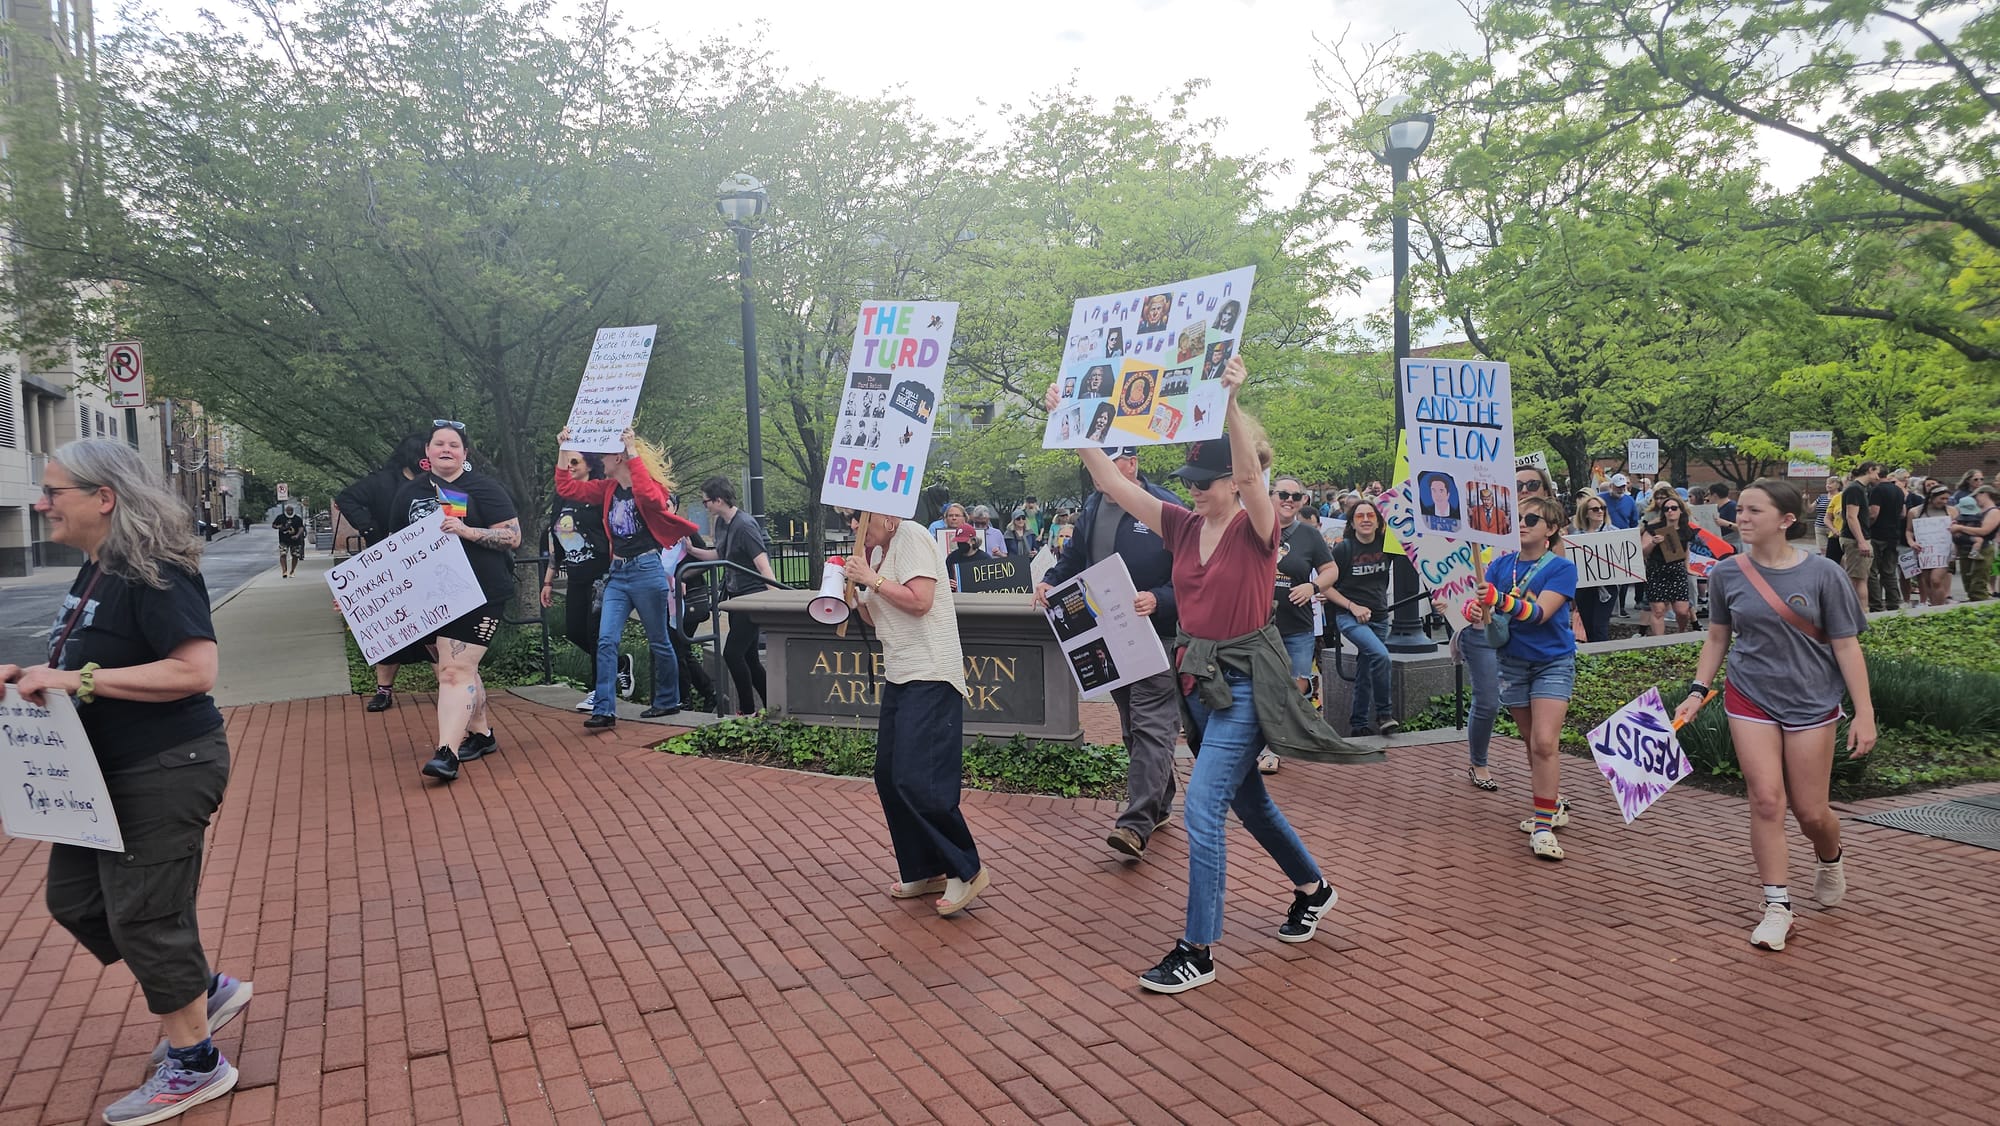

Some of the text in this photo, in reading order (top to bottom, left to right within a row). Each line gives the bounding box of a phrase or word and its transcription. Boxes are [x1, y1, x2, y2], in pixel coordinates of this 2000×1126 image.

[863, 306, 914, 335] THE
[864, 338, 939, 368] TURD
[1407, 363, 1496, 399] F'ELON
[1416, 396, 1500, 426] AND THE
[1419, 426, 1500, 462] FELON
[1630, 451, 1656, 460] FIGHT
[1631, 441, 1650, 450] WE
[828, 456, 915, 495] REICH
[1630, 462, 1655, 472] BACK
[357, 550, 383, 568] THIS
[386, 540, 397, 552] IS
[401, 527, 424, 544] HOW
[1565, 541, 1637, 582] TRUMP
[339, 535, 450, 611] DEMOCRACY DIES WITH
[973, 561, 1015, 583] DEFEND
[350, 579, 413, 624] THUNDEROUS
[365, 642, 385, 660] CAN
[387, 634, 398, 649] WE
[399, 622, 421, 642] MAYBE
[3, 725, 29, 747] Right
[39, 727, 66, 749] Left
[1594, 720, 1681, 781] RESIST
[47, 763, 70, 777] about
[23, 783, 50, 814] Right
